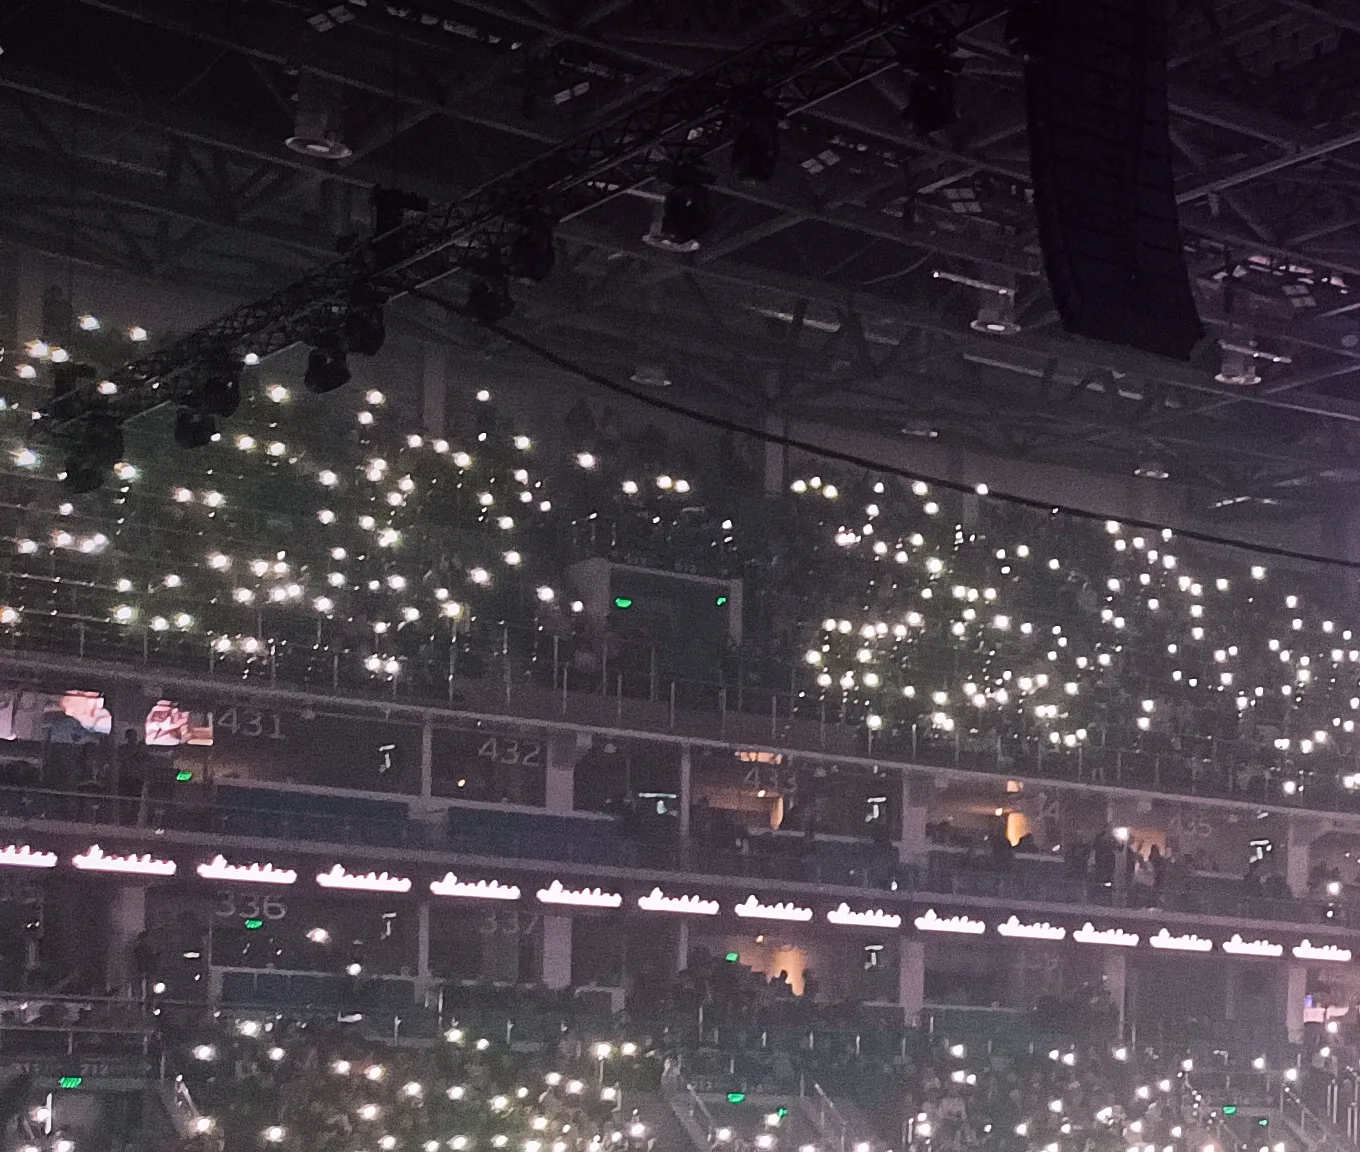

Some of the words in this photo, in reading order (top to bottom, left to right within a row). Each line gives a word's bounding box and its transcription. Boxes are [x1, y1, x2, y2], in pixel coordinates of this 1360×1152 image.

[478, 737, 542, 766] 432
[216, 890, 288, 921] 336
[479, 910, 542, 935] 337
